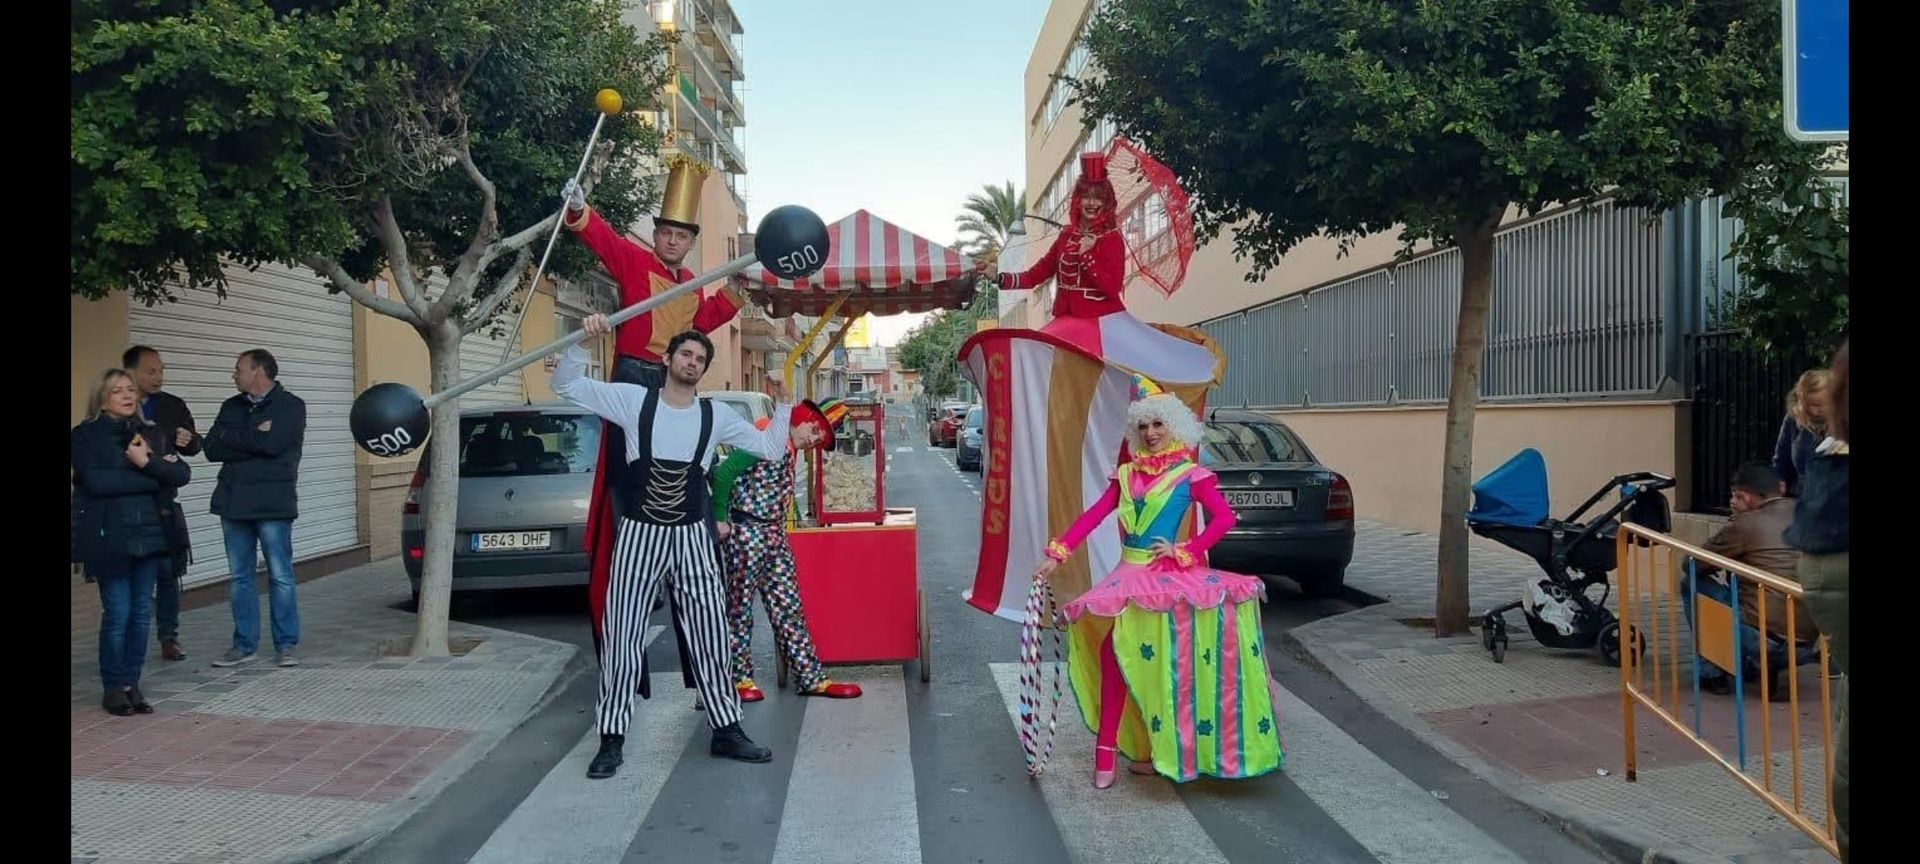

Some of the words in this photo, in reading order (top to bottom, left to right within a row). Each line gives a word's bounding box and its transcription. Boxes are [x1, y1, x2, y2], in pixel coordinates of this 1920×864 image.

[777, 245, 819, 273] 500
[366, 427, 411, 455] 500
[986, 351, 1007, 535] CIRCUS
[1228, 492, 1260, 505] 2670
[1264, 492, 1288, 505] GJL
[482, 534, 515, 547] 5643
[522, 533, 548, 546] DHF
